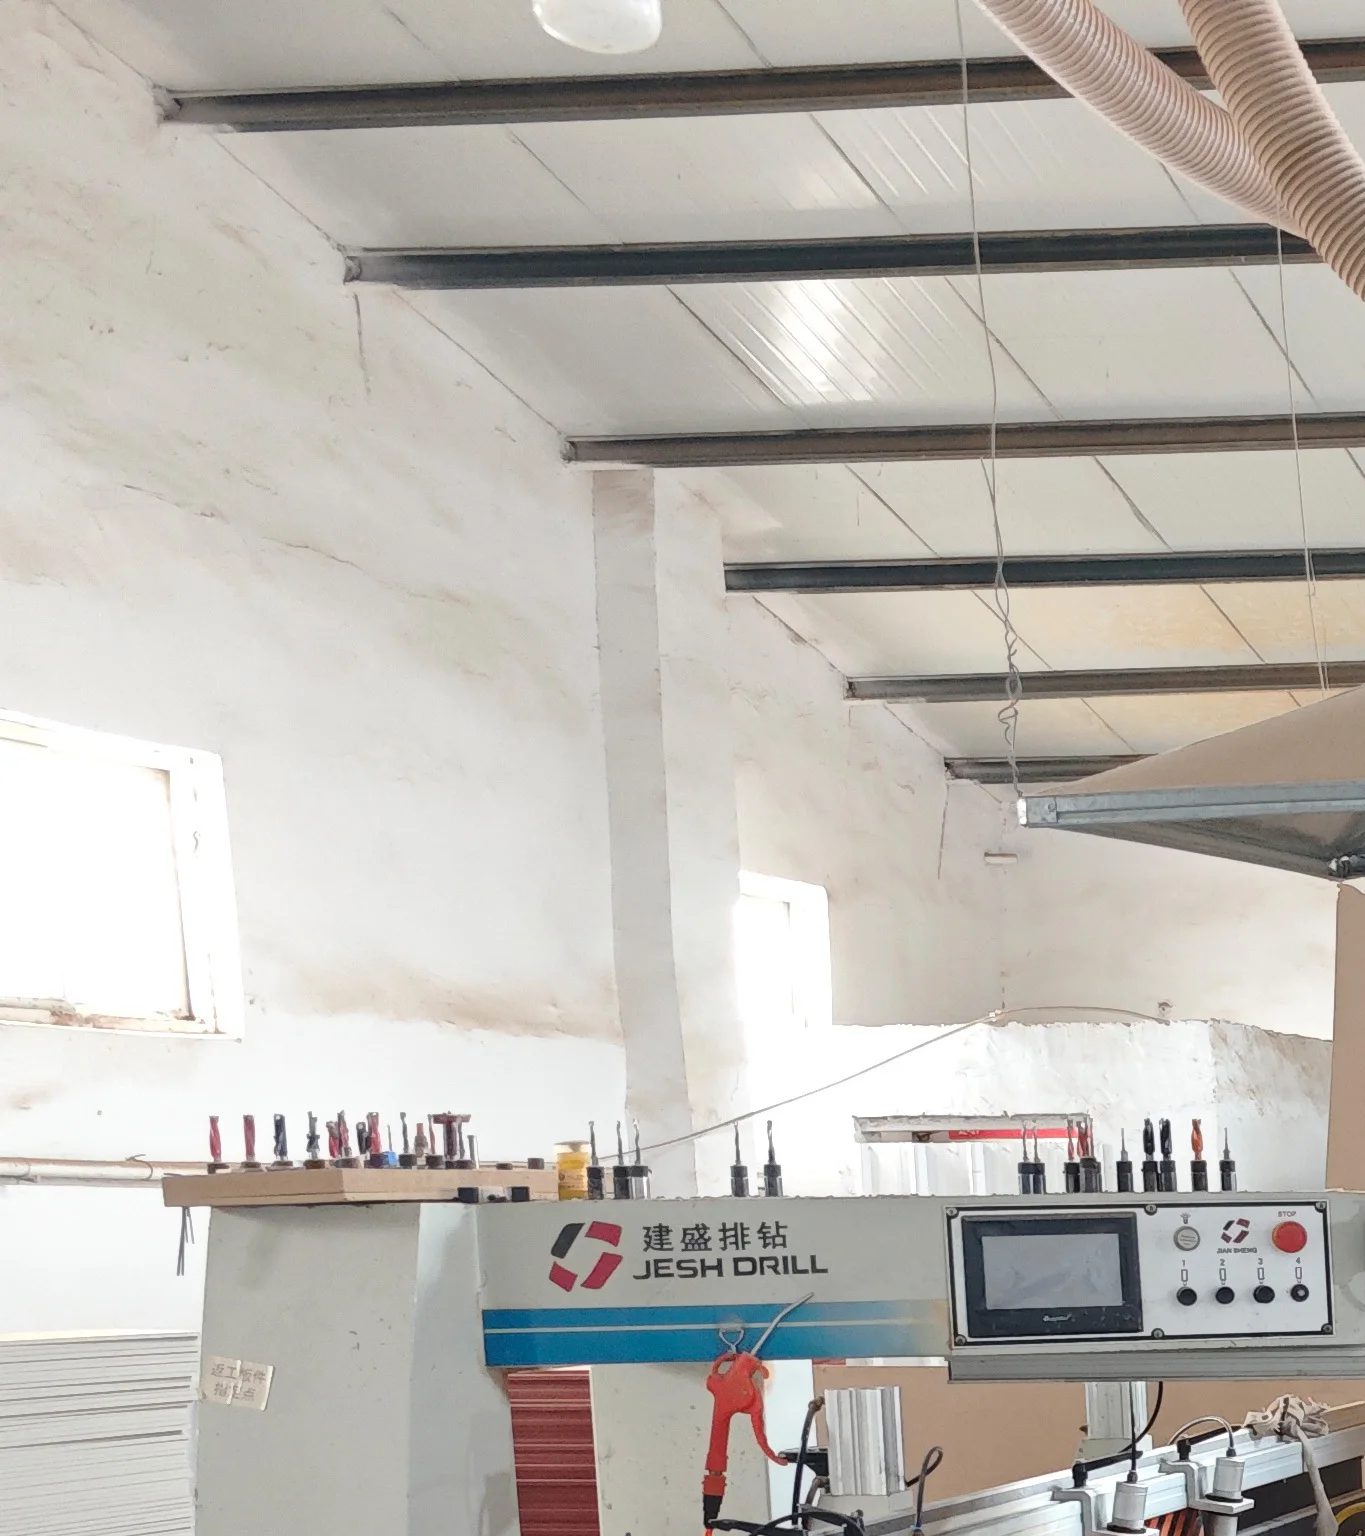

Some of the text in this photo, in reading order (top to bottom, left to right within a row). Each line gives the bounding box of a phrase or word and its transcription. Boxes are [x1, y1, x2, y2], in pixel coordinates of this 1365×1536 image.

[1277, 1210, 1297, 1218] STOP
[642, 1221, 788, 1252] 建盛排钻
[633, 1254, 829, 1280] JESH DRILL
